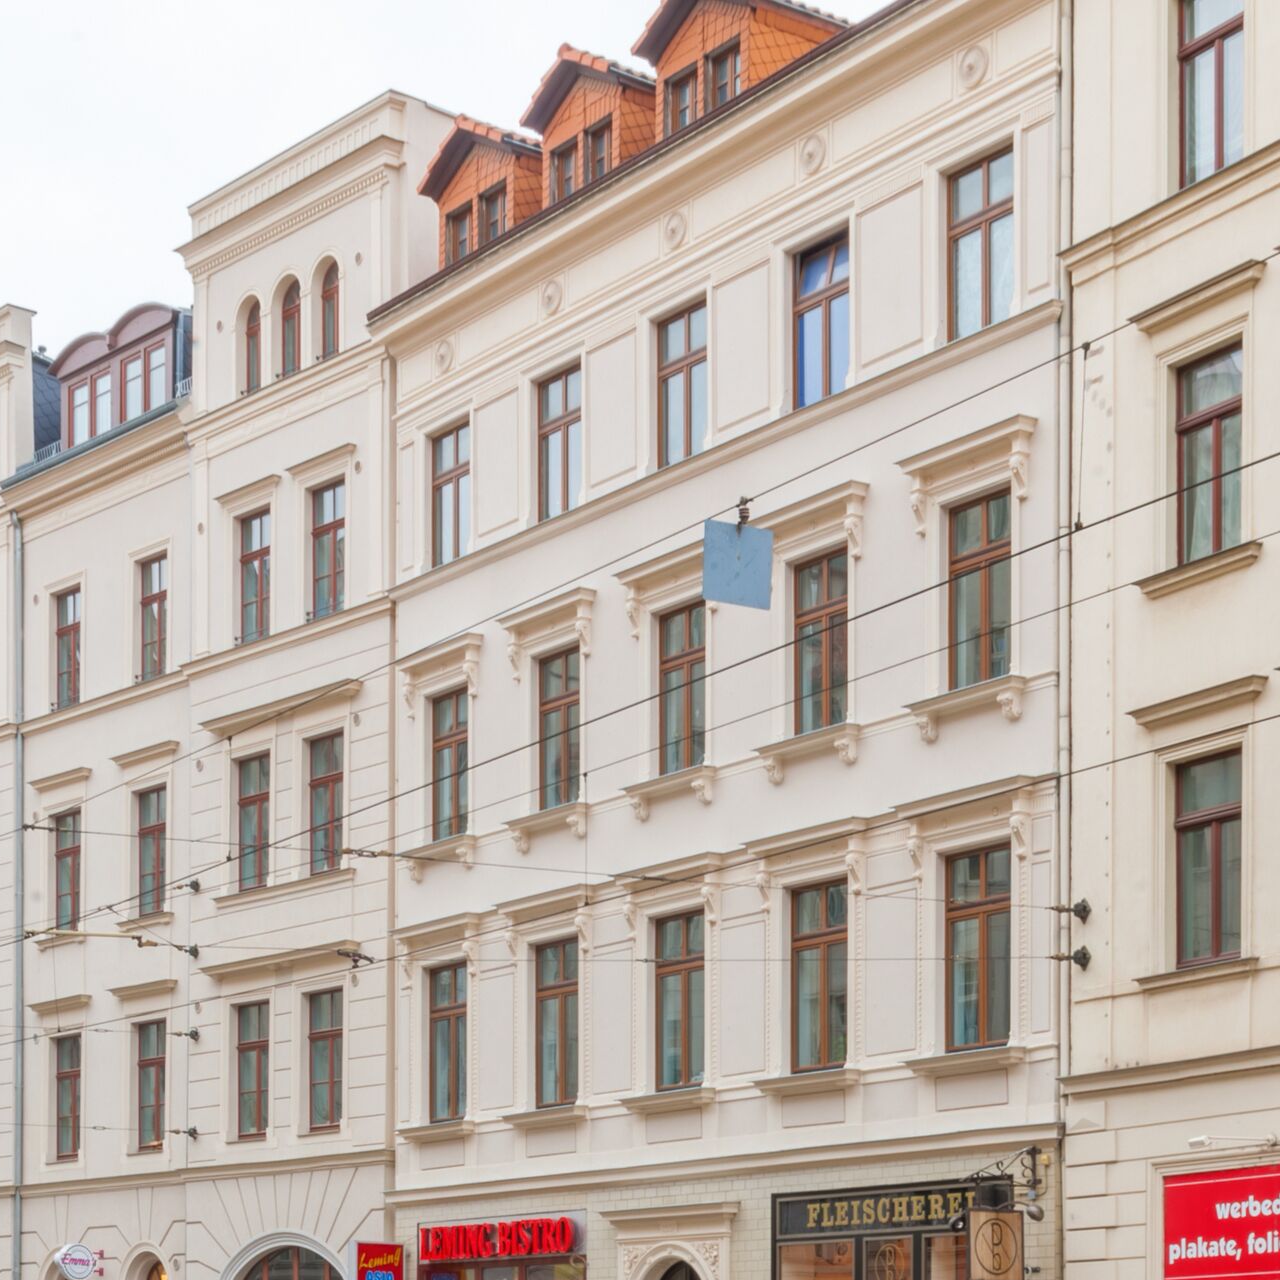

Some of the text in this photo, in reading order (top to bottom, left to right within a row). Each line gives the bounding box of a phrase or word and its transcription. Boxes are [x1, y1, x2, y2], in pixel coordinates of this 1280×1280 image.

[420, 1216, 574, 1260] LEMING BISTRO
[1169, 1236, 1242, 1265] plakate,
[61, 1252, 97, 1267] Emma's
[359, 1247, 401, 1271] Leming
